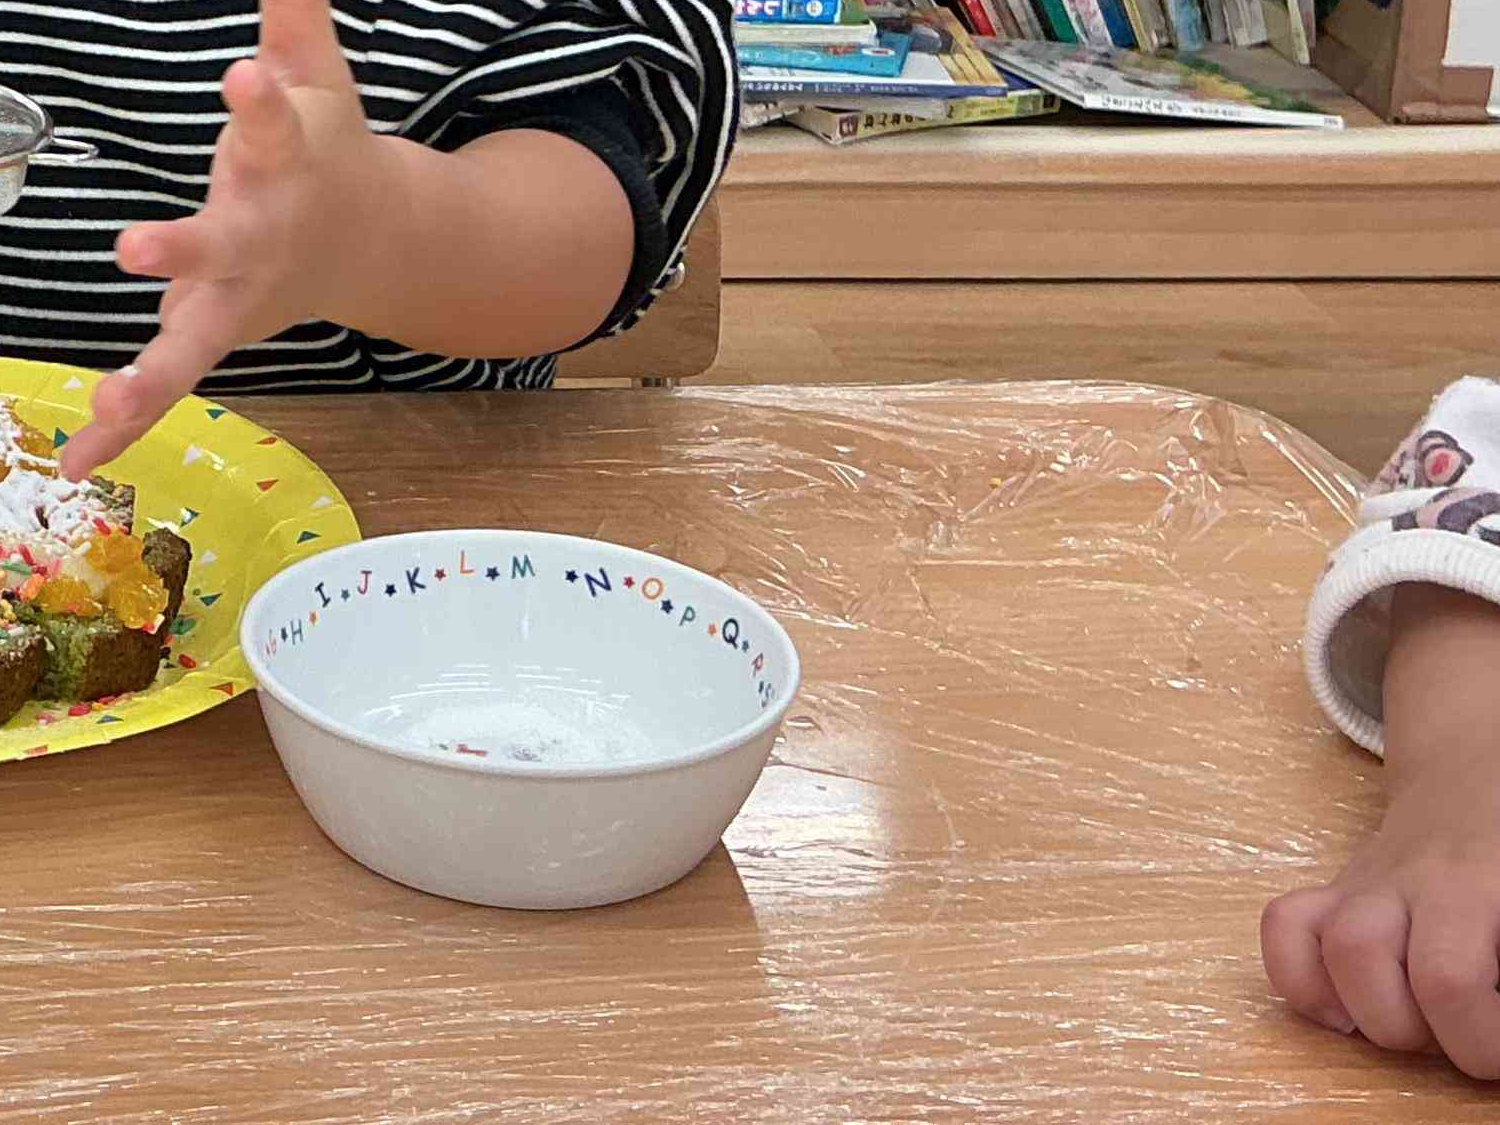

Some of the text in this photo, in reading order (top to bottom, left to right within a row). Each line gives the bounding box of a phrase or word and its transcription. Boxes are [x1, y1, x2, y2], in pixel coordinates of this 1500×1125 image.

[290, 618, 304, 645] H
[315, 582, 331, 608] I
[358, 570, 373, 594] J
[406, 566, 426, 594] K
[459, 550, 474, 574] L
[512, 554, 536, 579] M
[584, 567, 612, 597] N
[642, 578, 664, 600] O
[679, 606, 696, 626] P
[722, 618, 738, 650] Q
